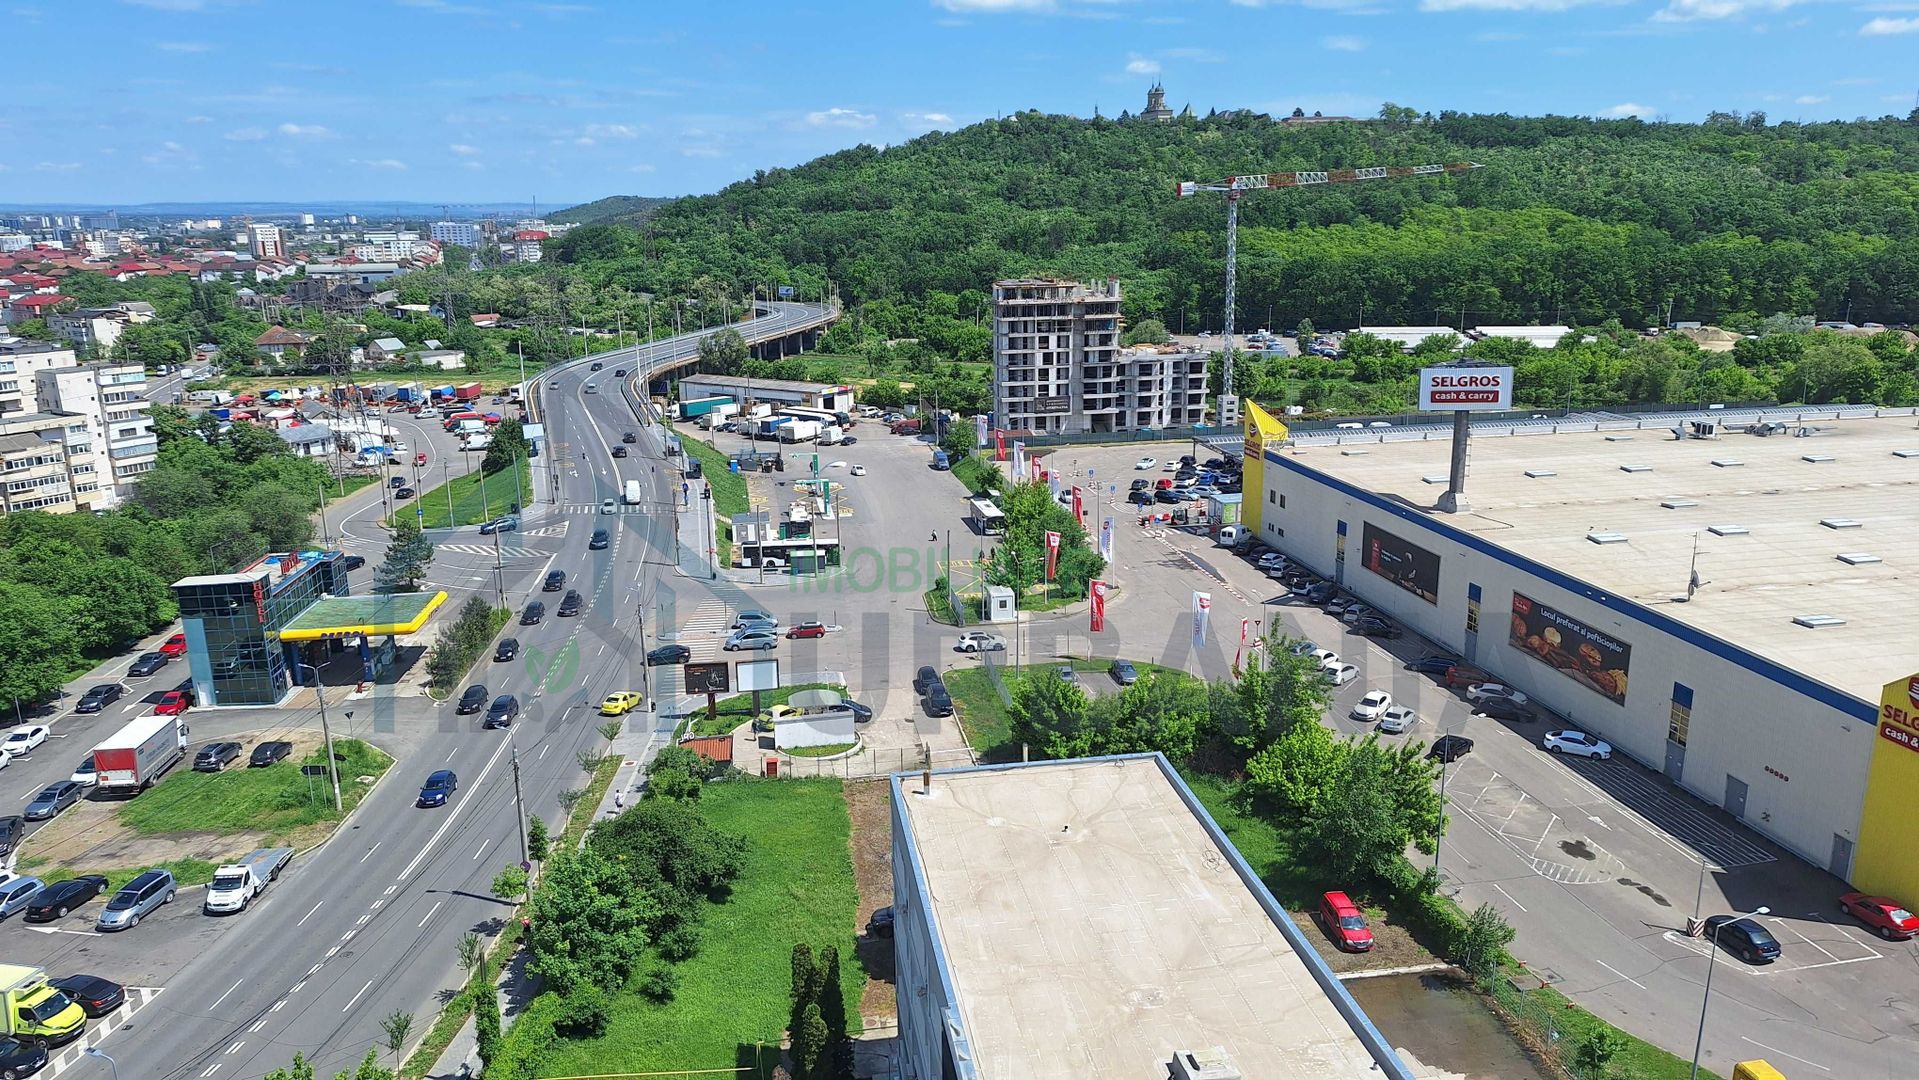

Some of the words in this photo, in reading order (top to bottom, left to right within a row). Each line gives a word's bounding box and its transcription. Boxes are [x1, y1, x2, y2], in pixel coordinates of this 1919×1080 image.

[1431, 375, 1500, 388] SELGROS
[1435, 391, 1457, 400] cash
[1458, 391, 1467, 400] &
[1468, 391, 1494, 401] carry
[1540, 607, 1556, 621] Locul
[1556, 616, 1580, 633] preferat
[1885, 727, 1909, 744] cash
[1910, 737, 1919, 748] &
